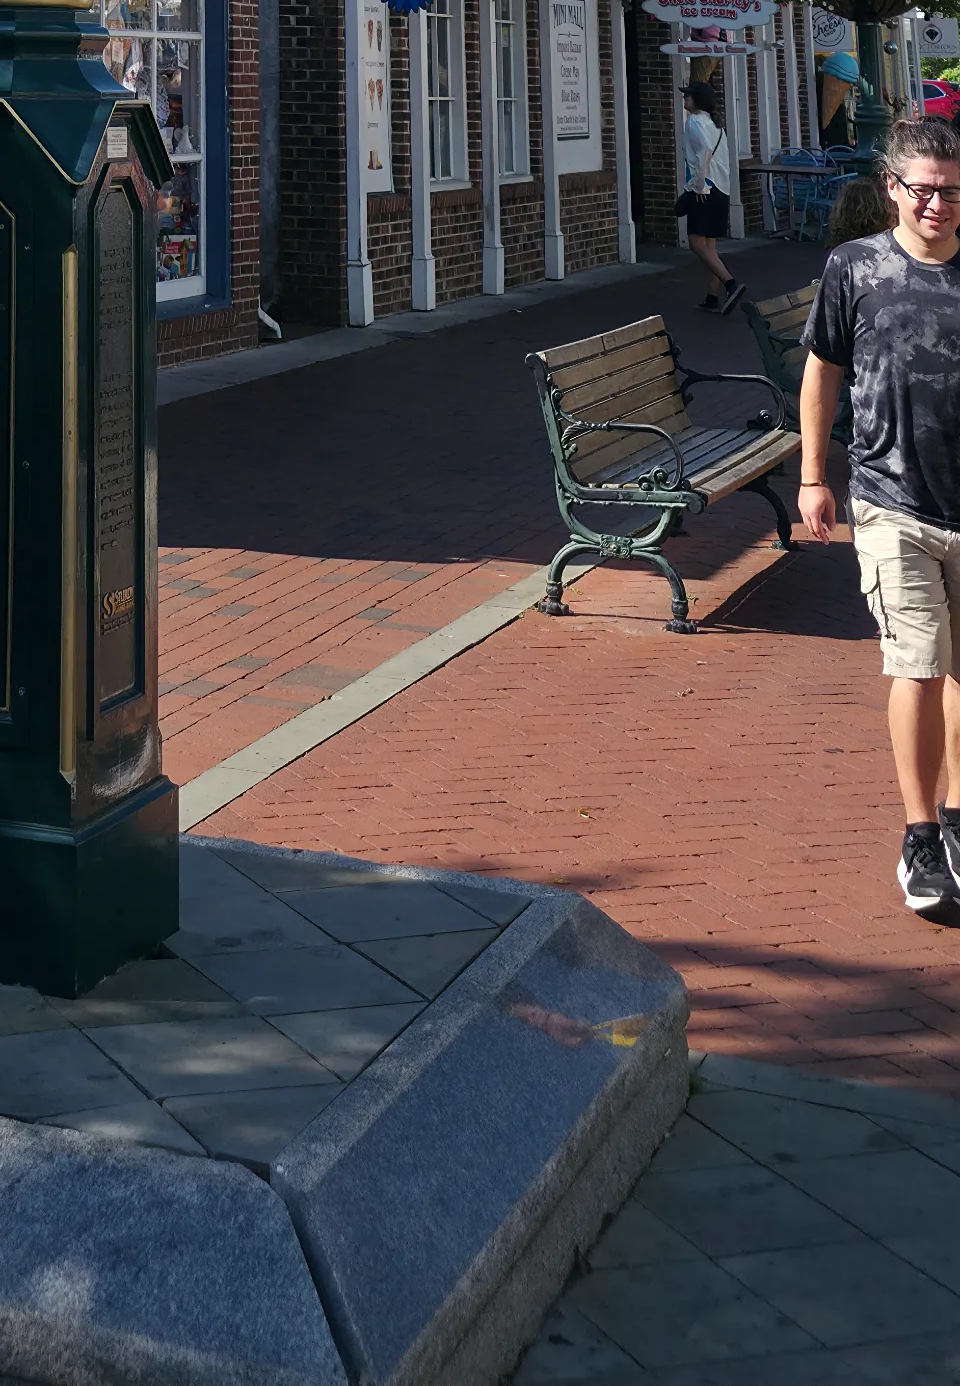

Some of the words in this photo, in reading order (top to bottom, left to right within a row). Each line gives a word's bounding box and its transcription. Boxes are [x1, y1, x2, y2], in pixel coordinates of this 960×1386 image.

[553, 3, 567, 29] MINI
[568, 5, 584, 31] MALL
[680, 6, 698, 18] ice
[699, 6, 738, 19] cream
